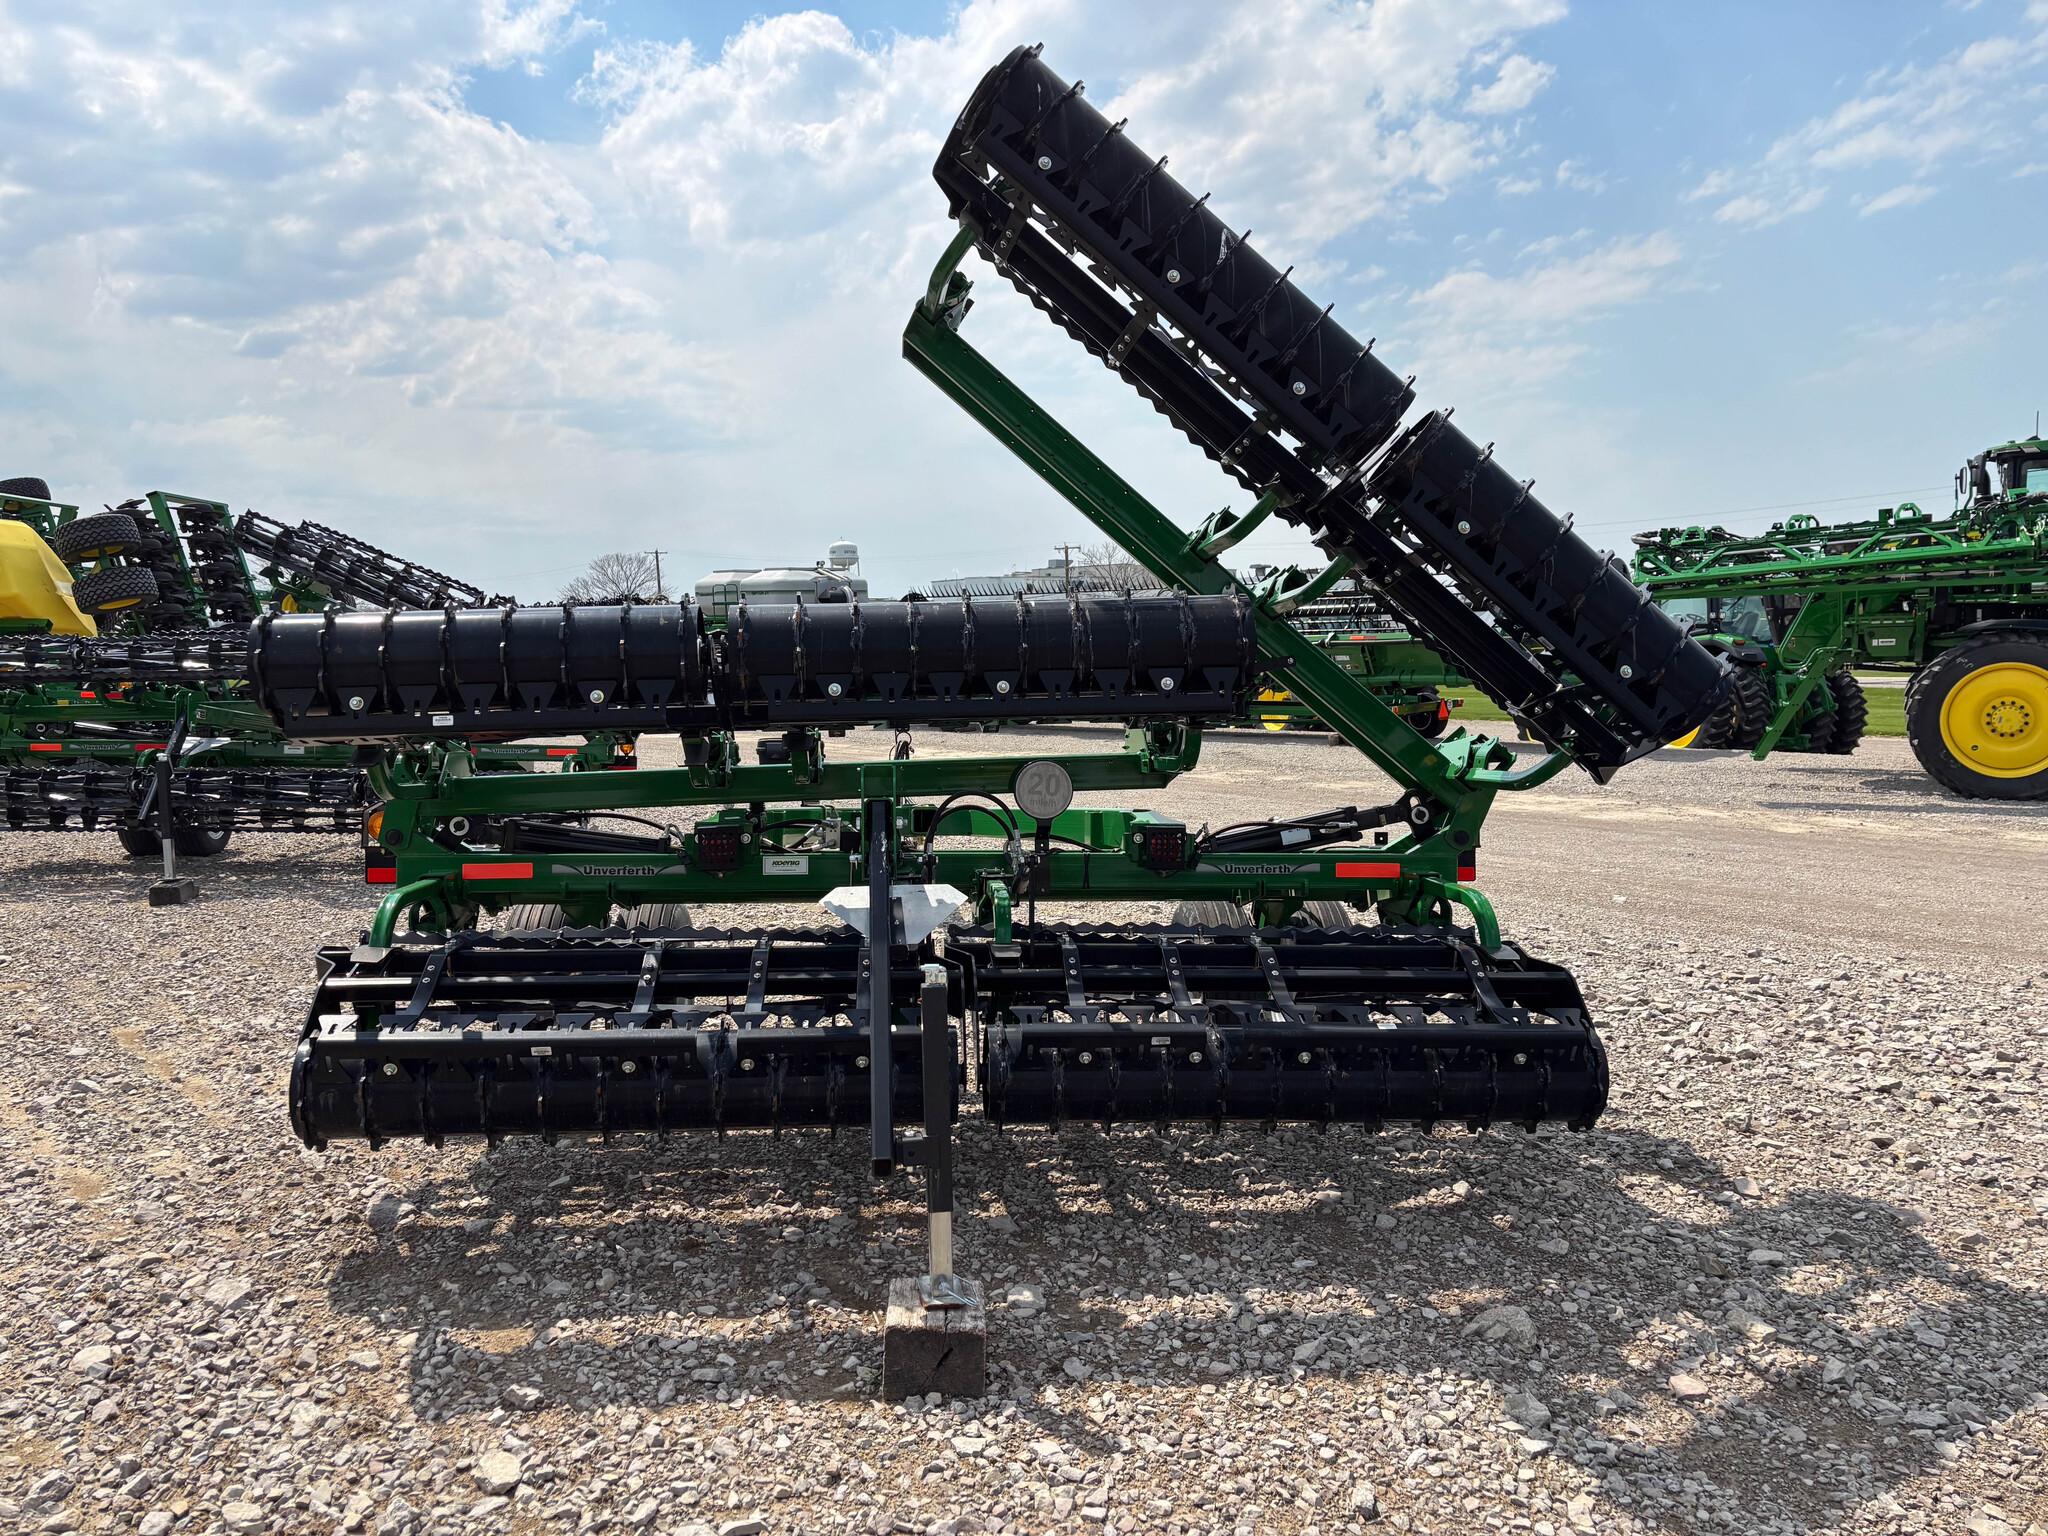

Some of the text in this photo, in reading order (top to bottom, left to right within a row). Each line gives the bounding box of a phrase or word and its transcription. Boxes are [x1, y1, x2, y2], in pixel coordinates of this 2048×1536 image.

[1028, 772, 1060, 797] 20
[583, 865, 655, 875] Unverferth
[1224, 864, 1291, 874] Unverferth
